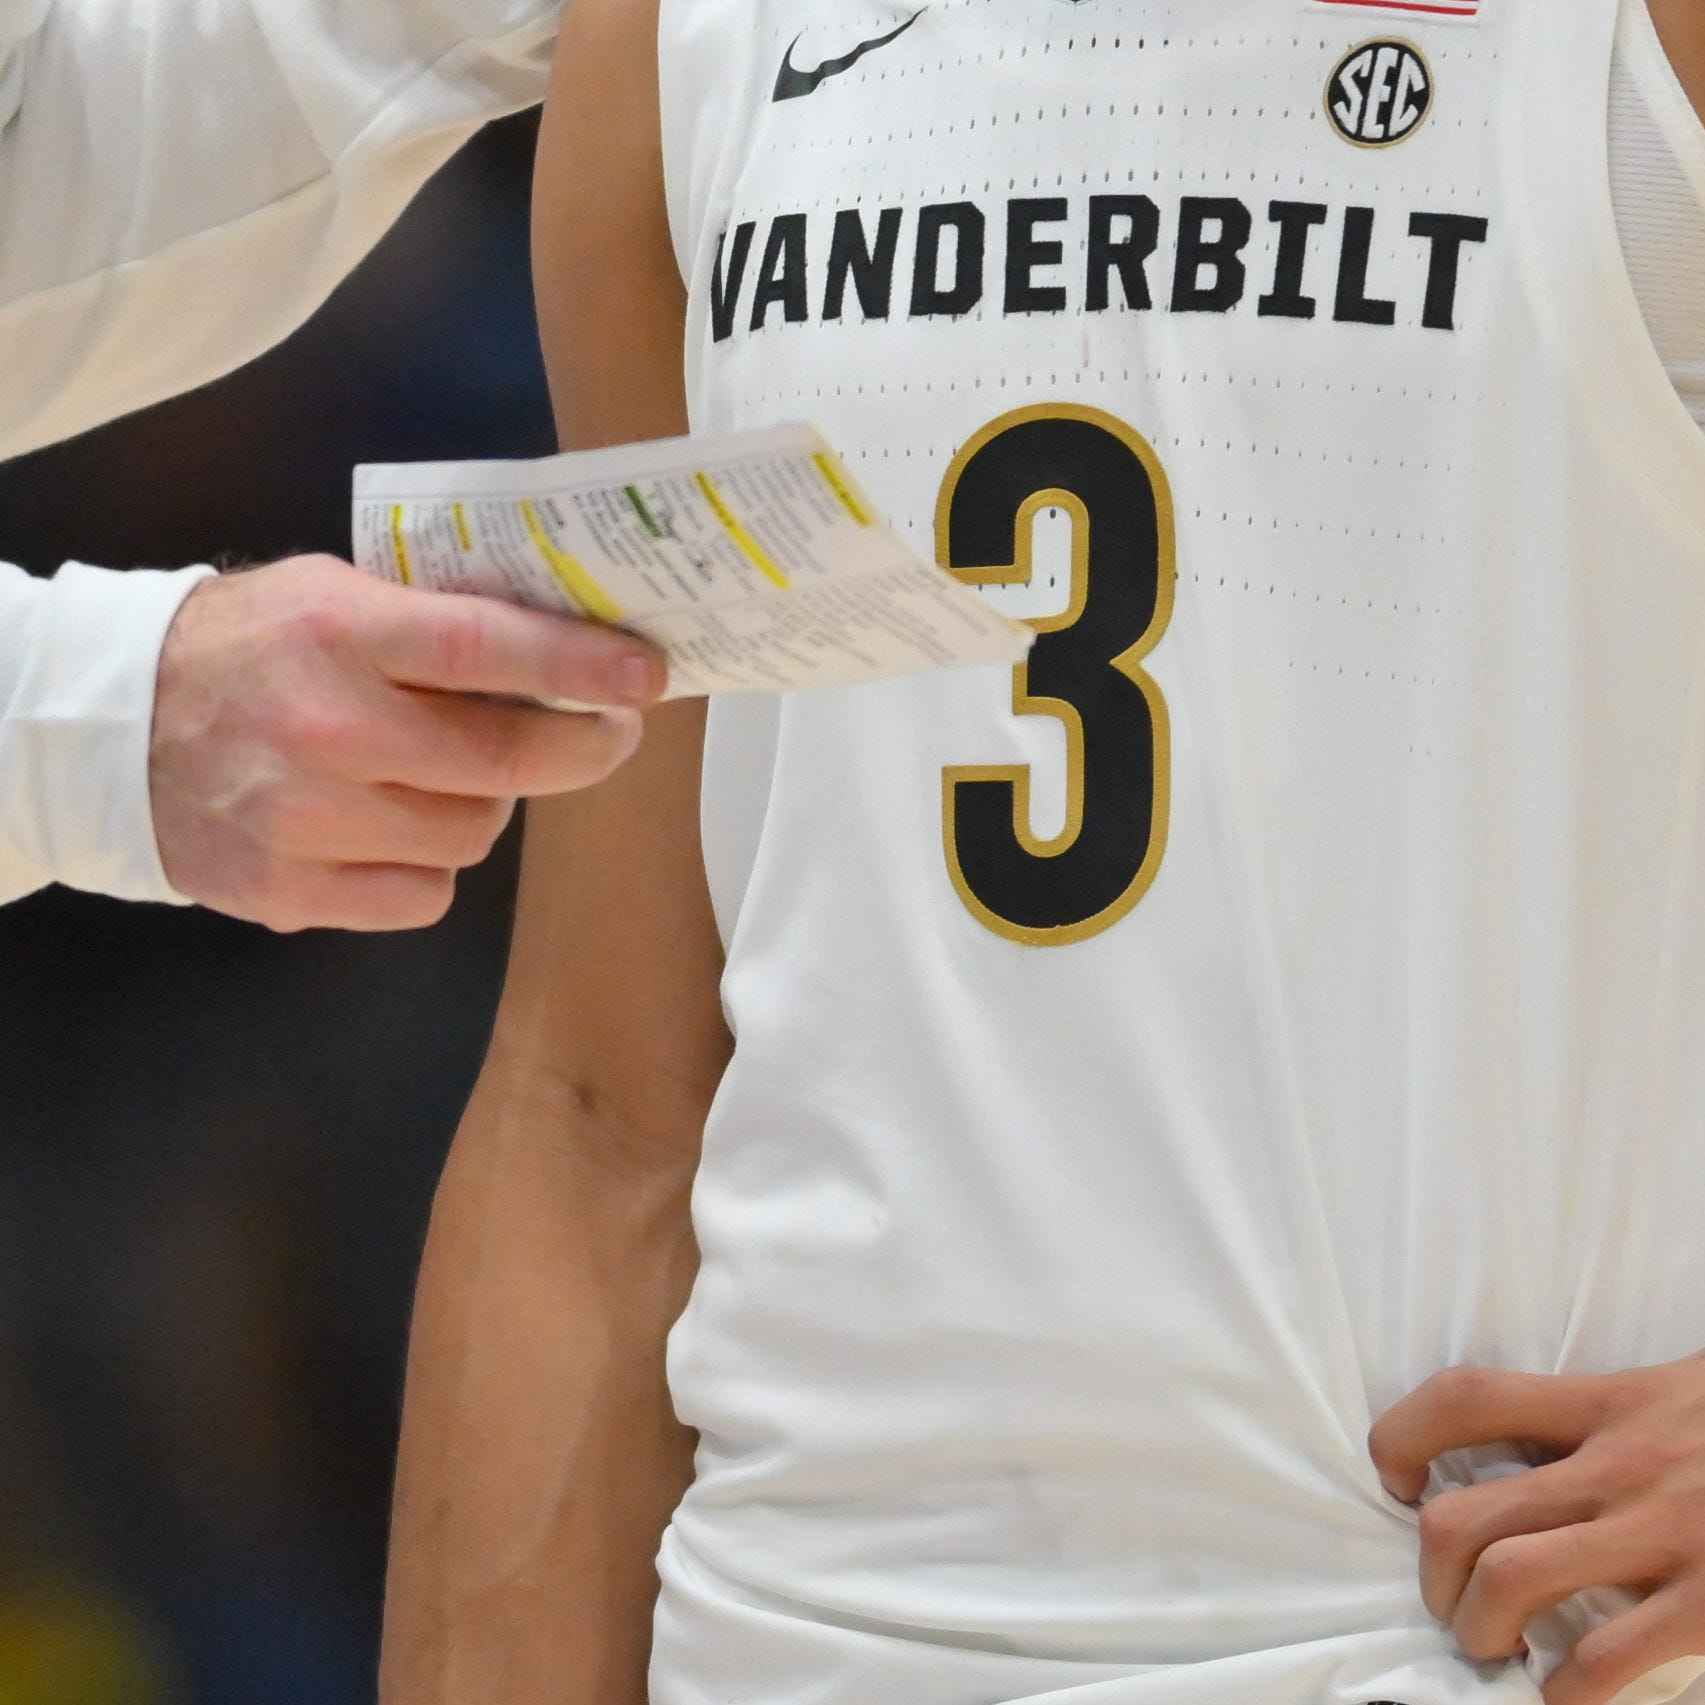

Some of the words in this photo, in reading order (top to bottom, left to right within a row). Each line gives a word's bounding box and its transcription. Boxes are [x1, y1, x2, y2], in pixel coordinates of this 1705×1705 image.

[1332, 46, 1426, 139] SEC
[710, 193, 1489, 344] VANDERBILT
[934, 401, 1177, 948] 3
